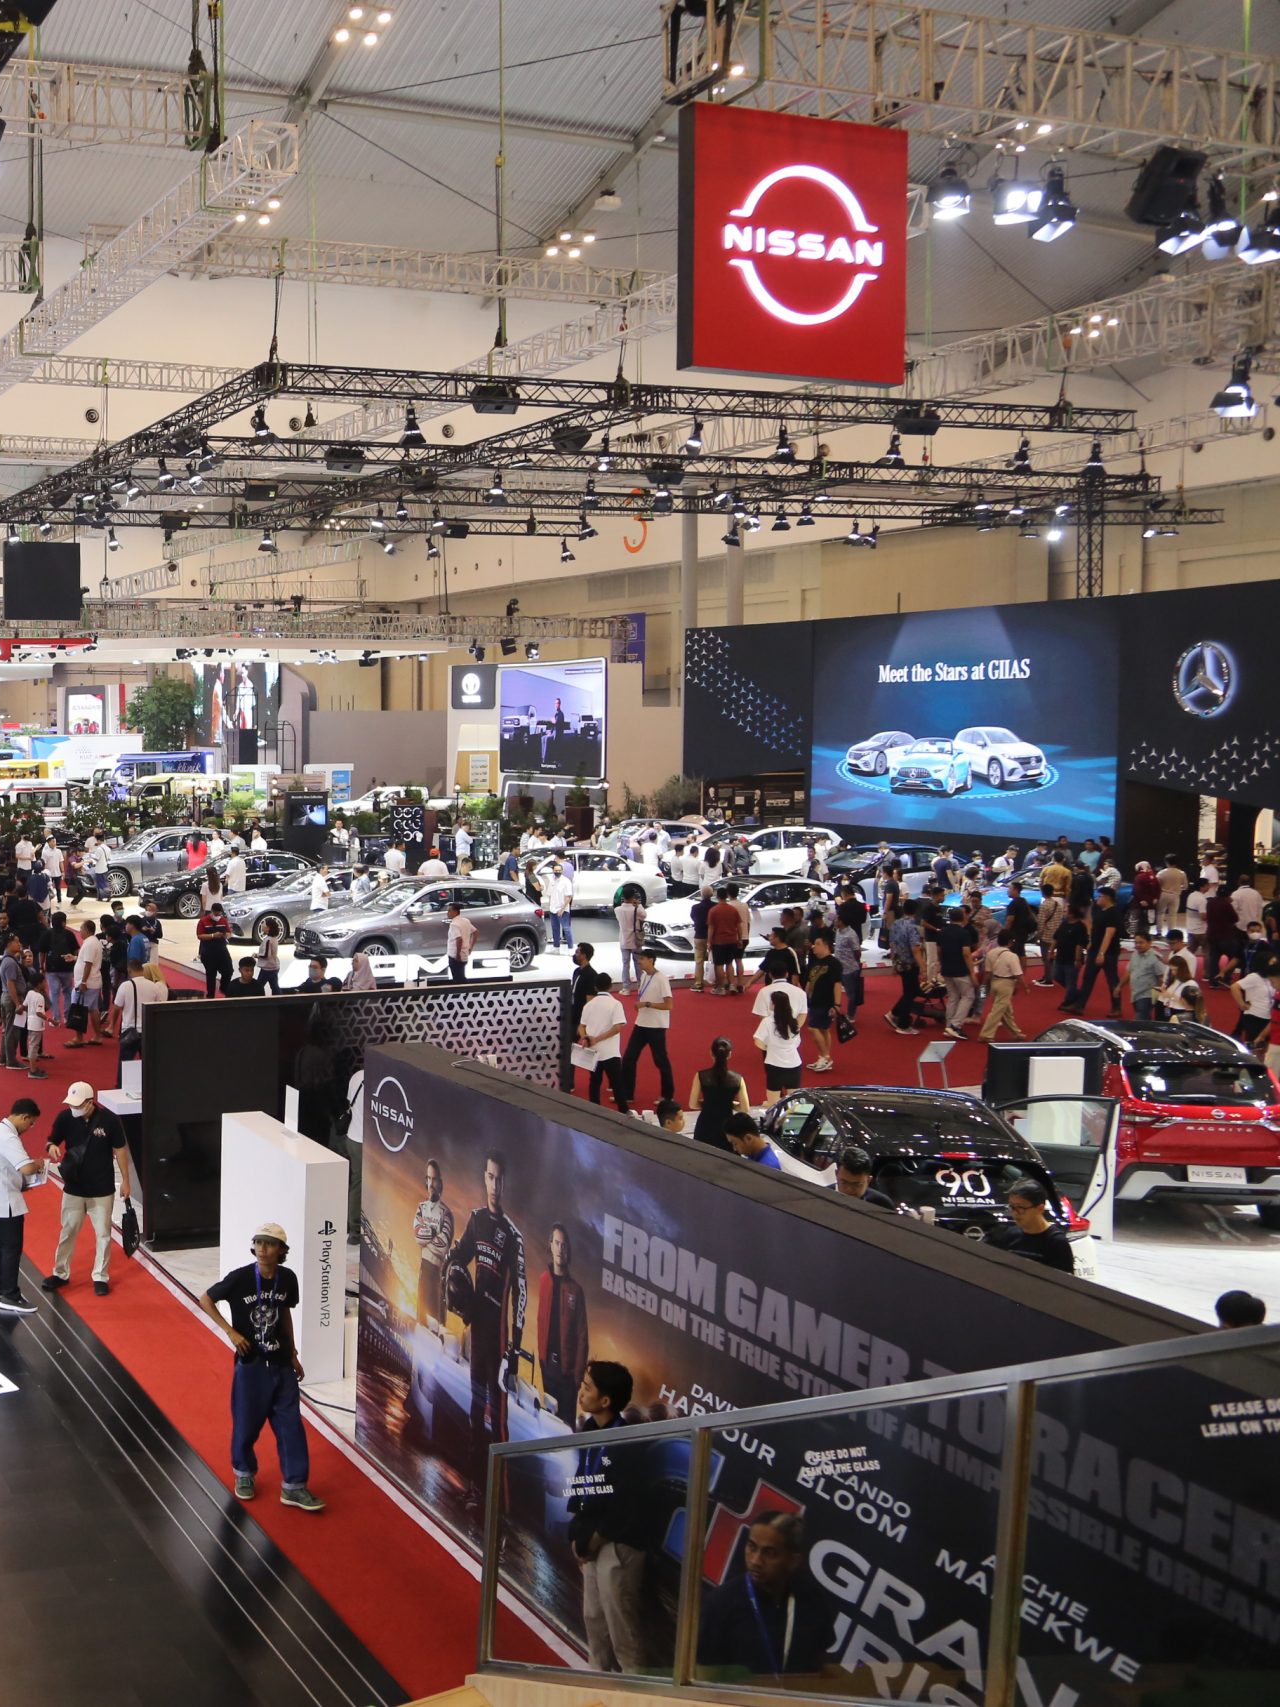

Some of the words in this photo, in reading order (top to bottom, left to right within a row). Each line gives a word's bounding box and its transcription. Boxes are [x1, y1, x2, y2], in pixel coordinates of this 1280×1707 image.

[723, 223, 883, 267] NISSAN
[878, 664, 908, 683] Meet
[911, 663, 932, 682] the
[935, 662, 968, 682] Stars
[971, 661, 985, 680] at
[988, 658, 1031, 680] GIIAS
[371, 1099, 414, 1130] NISSAN
[1185, 1125, 1253, 1133] MAGNITE
[935, 1167, 991, 1197] 90
[1191, 1170, 1242, 1179] NISSAN
[941, 1196, 995, 1205] NISSAN
[477, 1244, 502, 1263] NISSAN
[603, 1213, 717, 1315] FROM
[724, 1271, 910, 1390] GAMER
[923, 1358, 1008, 1455] TO
[1030, 1410, 1280, 1602] RACER
[1210, 1400, 1265, 1418] PLEASE
[658, 1384, 776, 1467] HAROUR
[1200, 1421, 1238, 1438] LEAN
[1240, 1420, 1262, 1435] ON
[601, 1267, 658, 1316] BASED
[660, 1298, 687, 1331] ON
[690, 1313, 724, 1351] THE
[728, 1332, 780, 1382] TRUE
[866, 1410, 898, 1440] OF
[901, 1423, 941, 1464] AN
[946, 1444, 1141, 1571] IMPSSIBLE
[1146, 1547, 1280, 1643] DREAM
[837, 1448, 849, 1459] DO
[850, 1446, 867, 1458] NOT
[566, 1475, 586, 1484] PLEASE
[586, 1475, 594, 1483] DO
[594, 1474, 605, 1482] NOT
[836, 1463, 852, 1474] THE
[854, 1460, 880, 1472] GLASS
[562, 1488, 577, 1497] LEAN
[577, 1487, 584, 1495] ON
[584, 1486, 595, 1495] THE
[596, 1485, 614, 1493] GLASS
[796, 1466, 908, 1543] BLOOM
[981, 1555, 1089, 1623] ACHIE
[809, 1539, 1079, 1707] GRAN
[935, 1549, 1141, 1684] MAEKWE
